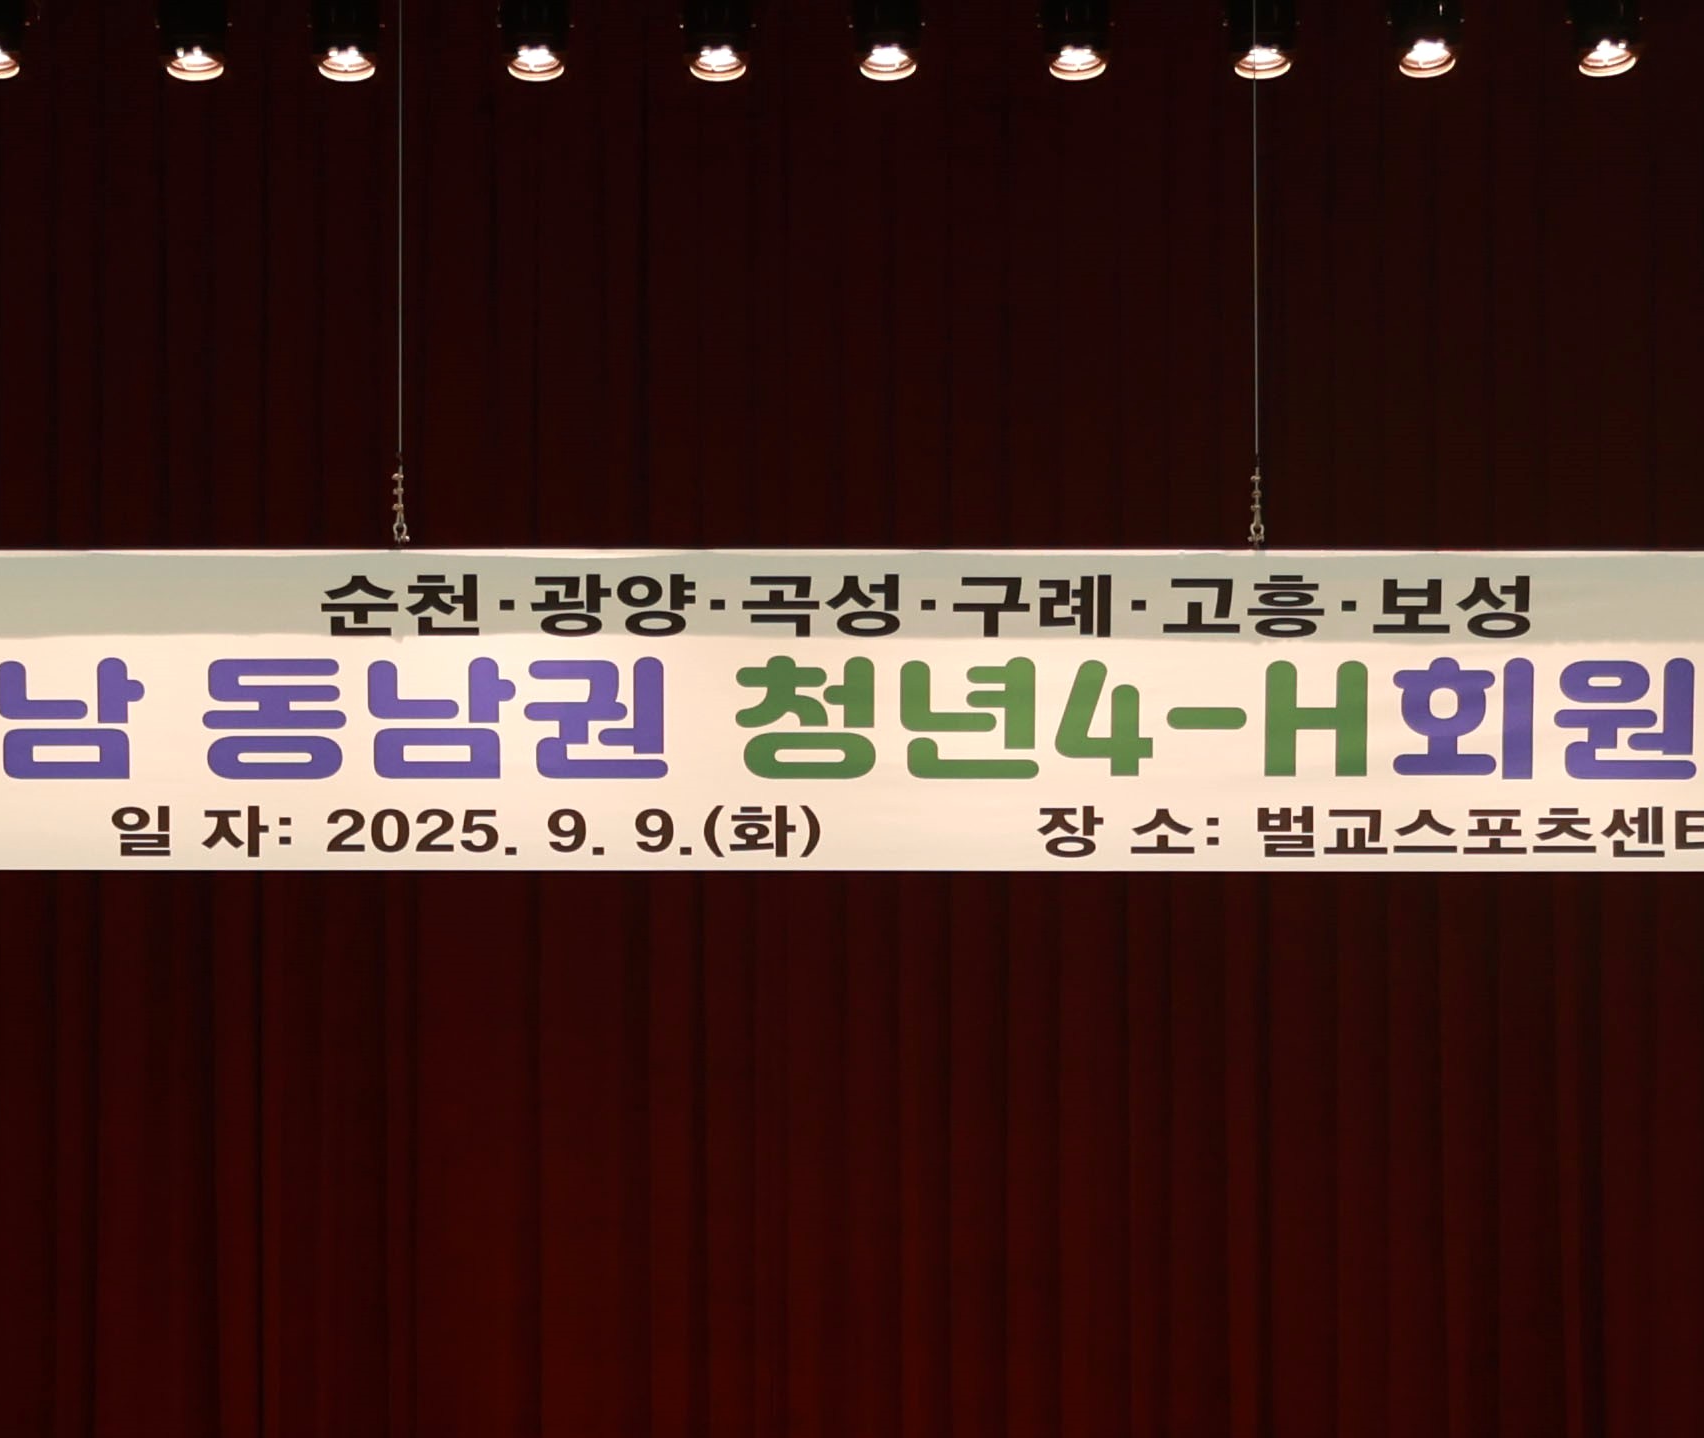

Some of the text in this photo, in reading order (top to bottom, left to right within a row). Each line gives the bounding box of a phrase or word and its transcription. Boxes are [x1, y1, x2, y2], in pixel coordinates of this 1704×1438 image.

[202, 656, 670, 780] 동남권
[734, 655, 1699, 780] 청년4-H회원
[110, 804, 822, 858] 일 자: 2025. 9. 9.(화)
[1038, 804, 1104, 859] 장
[1131, 807, 1220, 857] 소:
